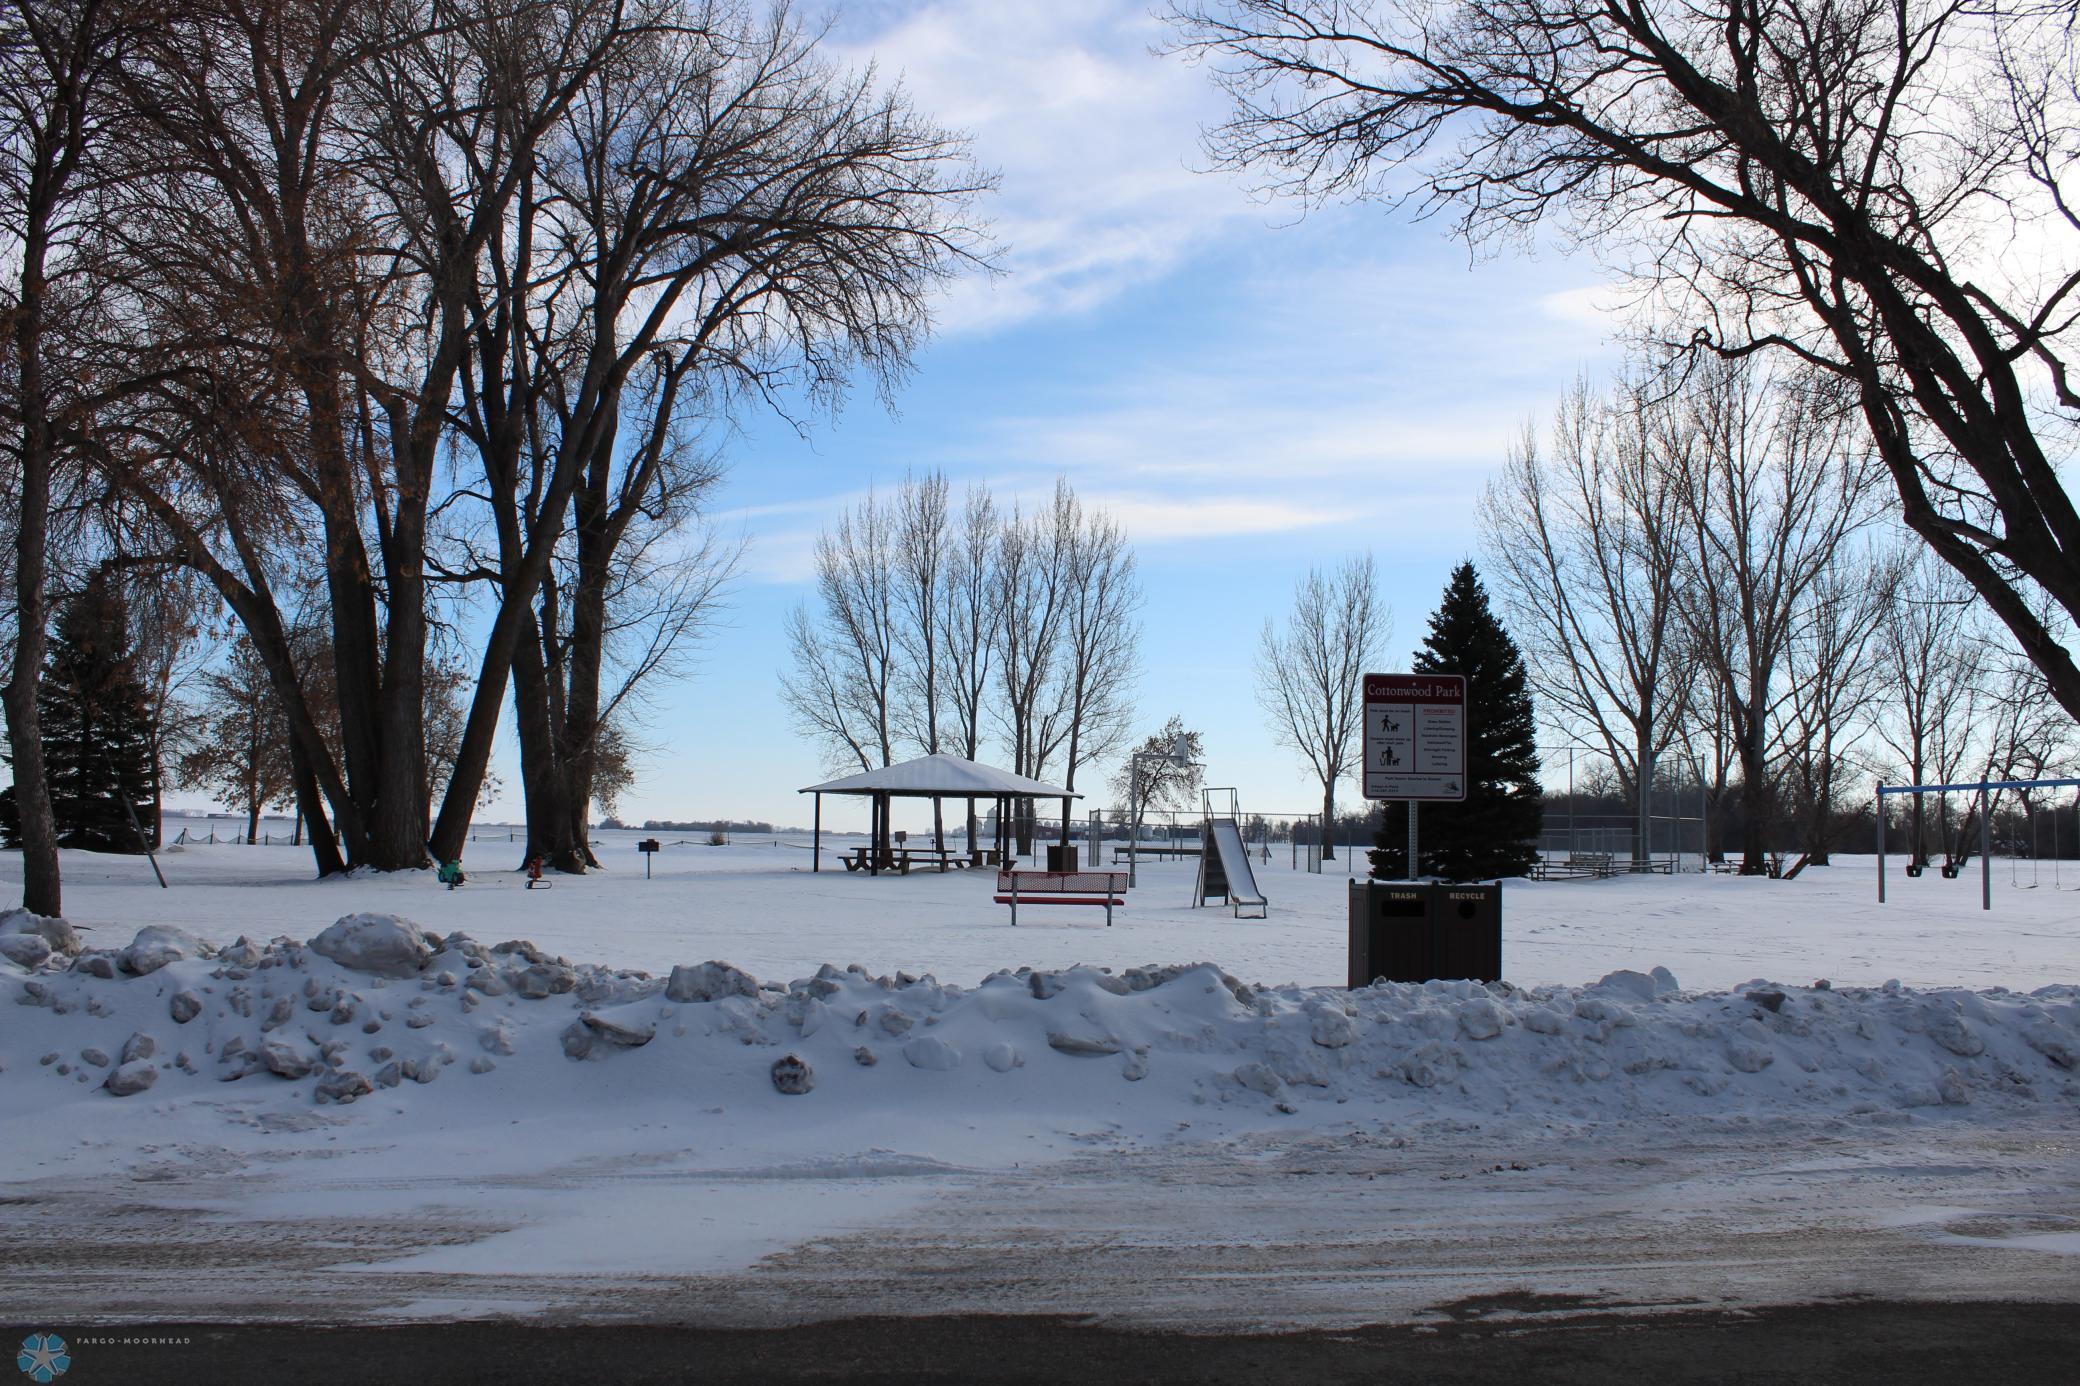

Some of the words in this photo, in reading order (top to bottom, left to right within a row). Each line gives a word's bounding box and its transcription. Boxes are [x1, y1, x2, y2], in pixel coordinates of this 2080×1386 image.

[1367, 683, 1432, 697] Cottonwood
[1435, 684, 1461, 697] Park
[1449, 892, 1485, 900] RECYCLE
